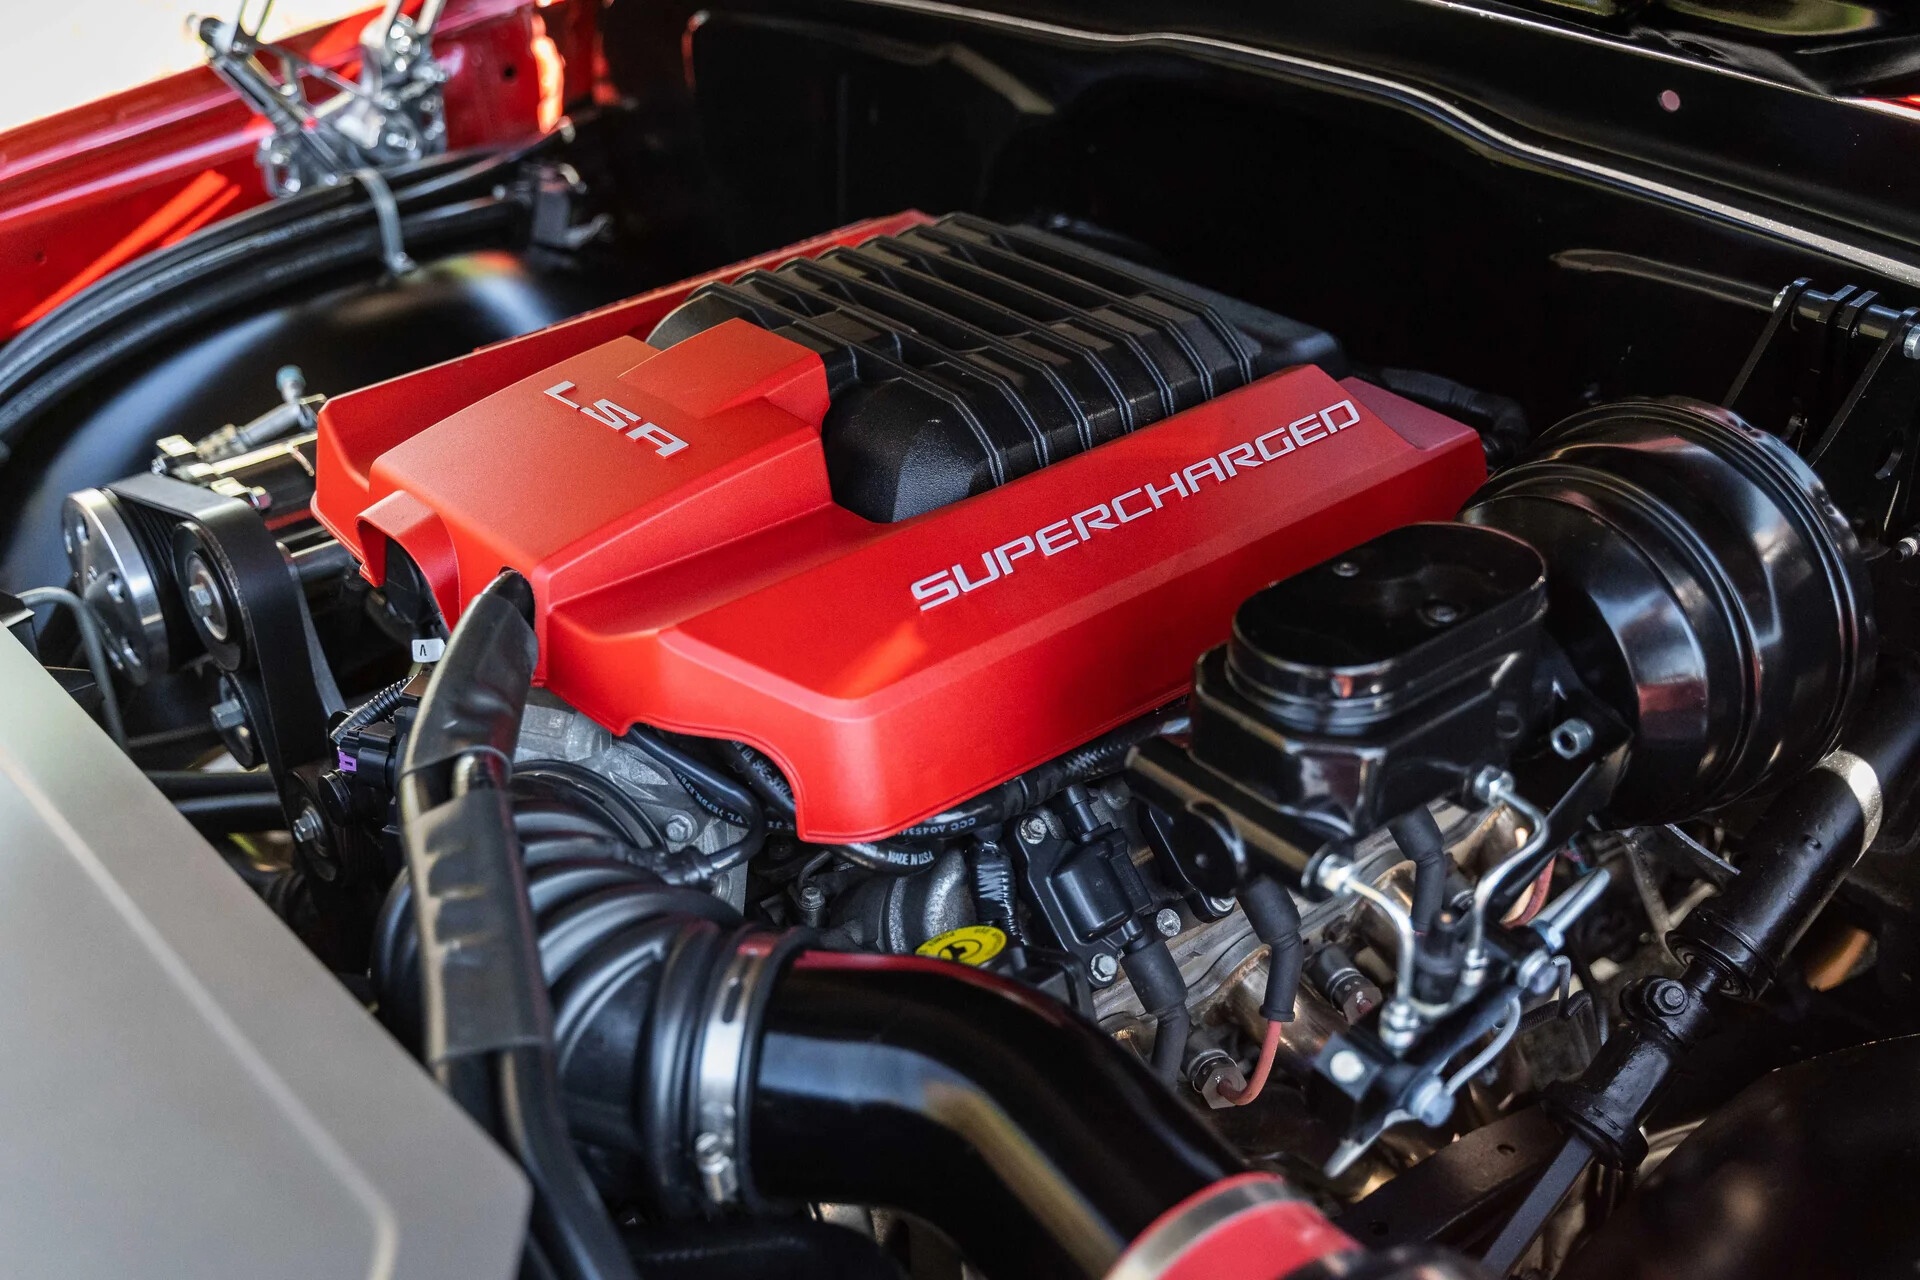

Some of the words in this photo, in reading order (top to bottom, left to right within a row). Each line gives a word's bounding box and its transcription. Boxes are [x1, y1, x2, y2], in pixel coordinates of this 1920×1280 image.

[544, 381, 689, 458] LSA
[911, 399, 1361, 611] SUPERCHARGED
[951, 817, 976, 831] CCC
[887, 850, 908, 866] MADE
[910, 853, 918, 866] IN
